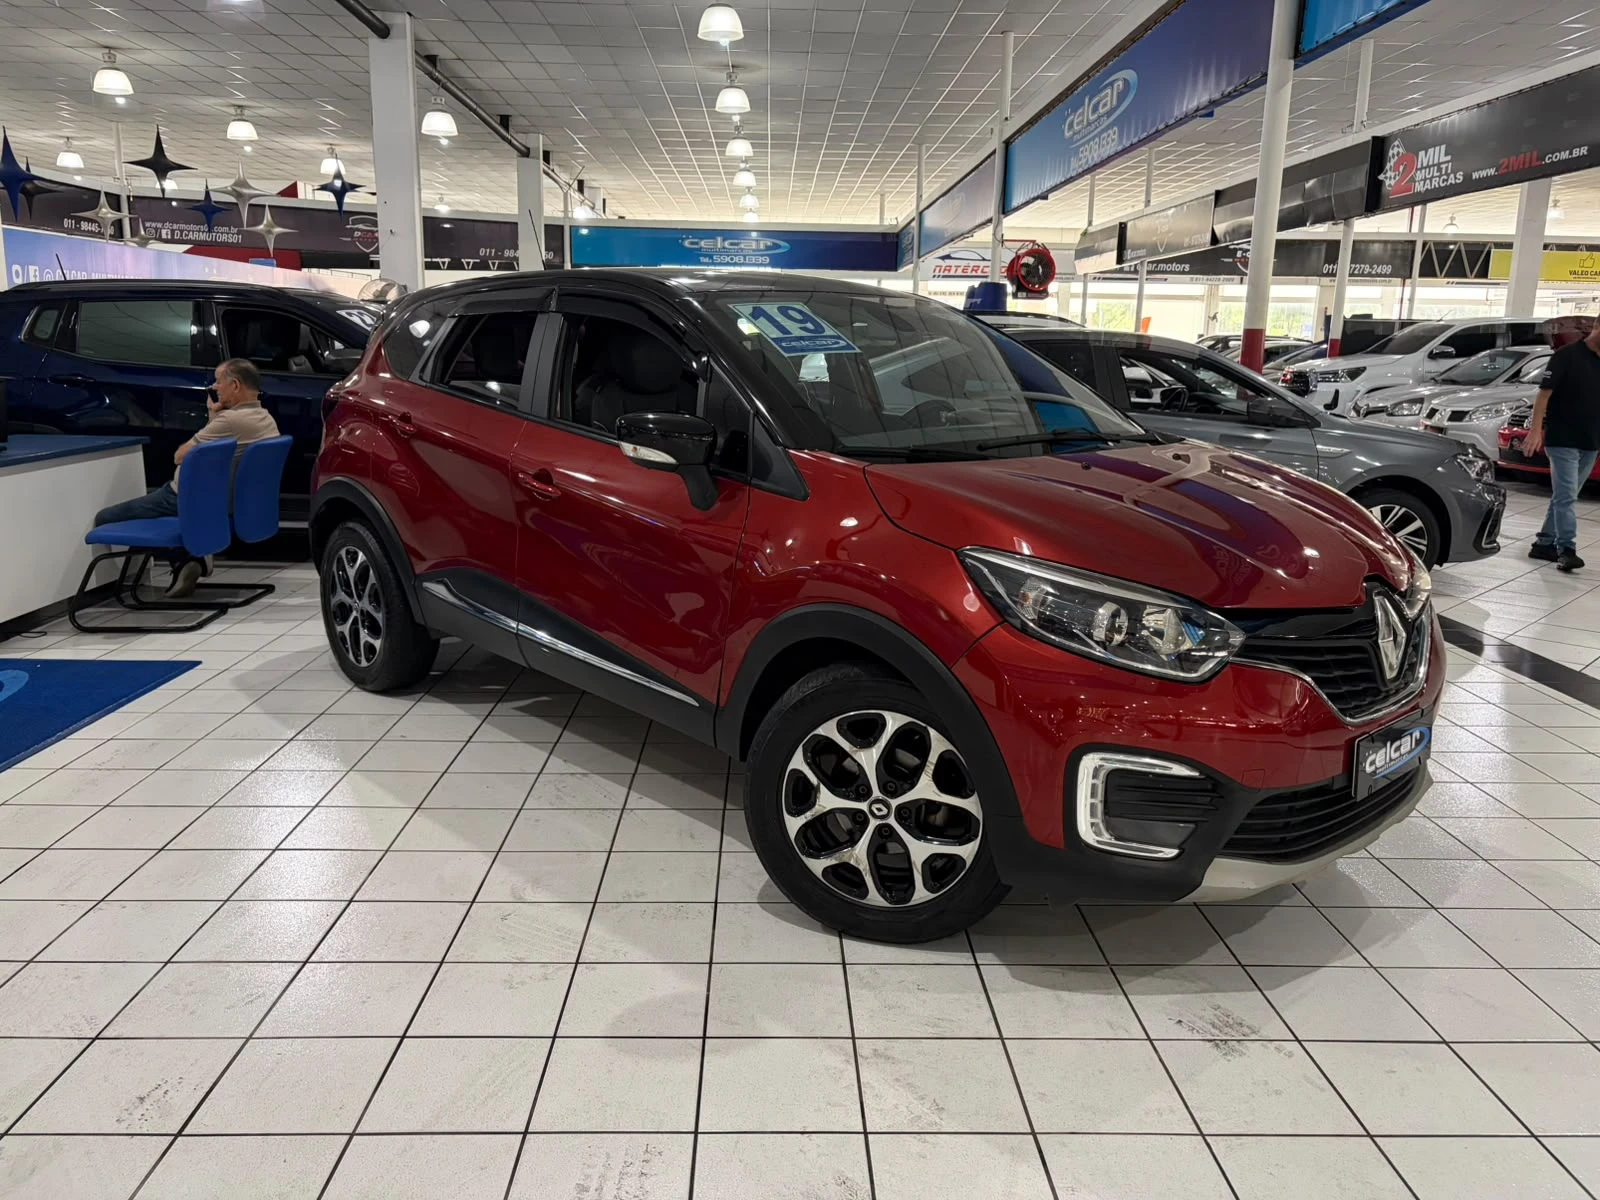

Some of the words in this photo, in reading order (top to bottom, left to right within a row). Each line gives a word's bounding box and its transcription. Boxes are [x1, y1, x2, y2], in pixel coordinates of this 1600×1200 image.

[1064, 79, 1125, 139] celcar
[1389, 152, 1417, 199] 2
[1417, 144, 1452, 169] MIL
[1416, 162, 1453, 181] MULTI
[1414, 171, 1464, 193] MARCAS
[145, 221, 239, 234] www.dcarmotors0.com.br
[682, 236, 773, 250] celcar
[479, 247, 496, 257] 011
[713, 255, 770, 264] 5908.1339
[1136, 261, 1191, 272] ear.motors
[932, 262, 1008, 275] NATÉRCO
[1322, 263, 1337, 274] 011
[1348, 264, 1392, 275] 7279-2499
[750, 305, 826, 336] 19
[1365, 730, 1420, 774] celcar
